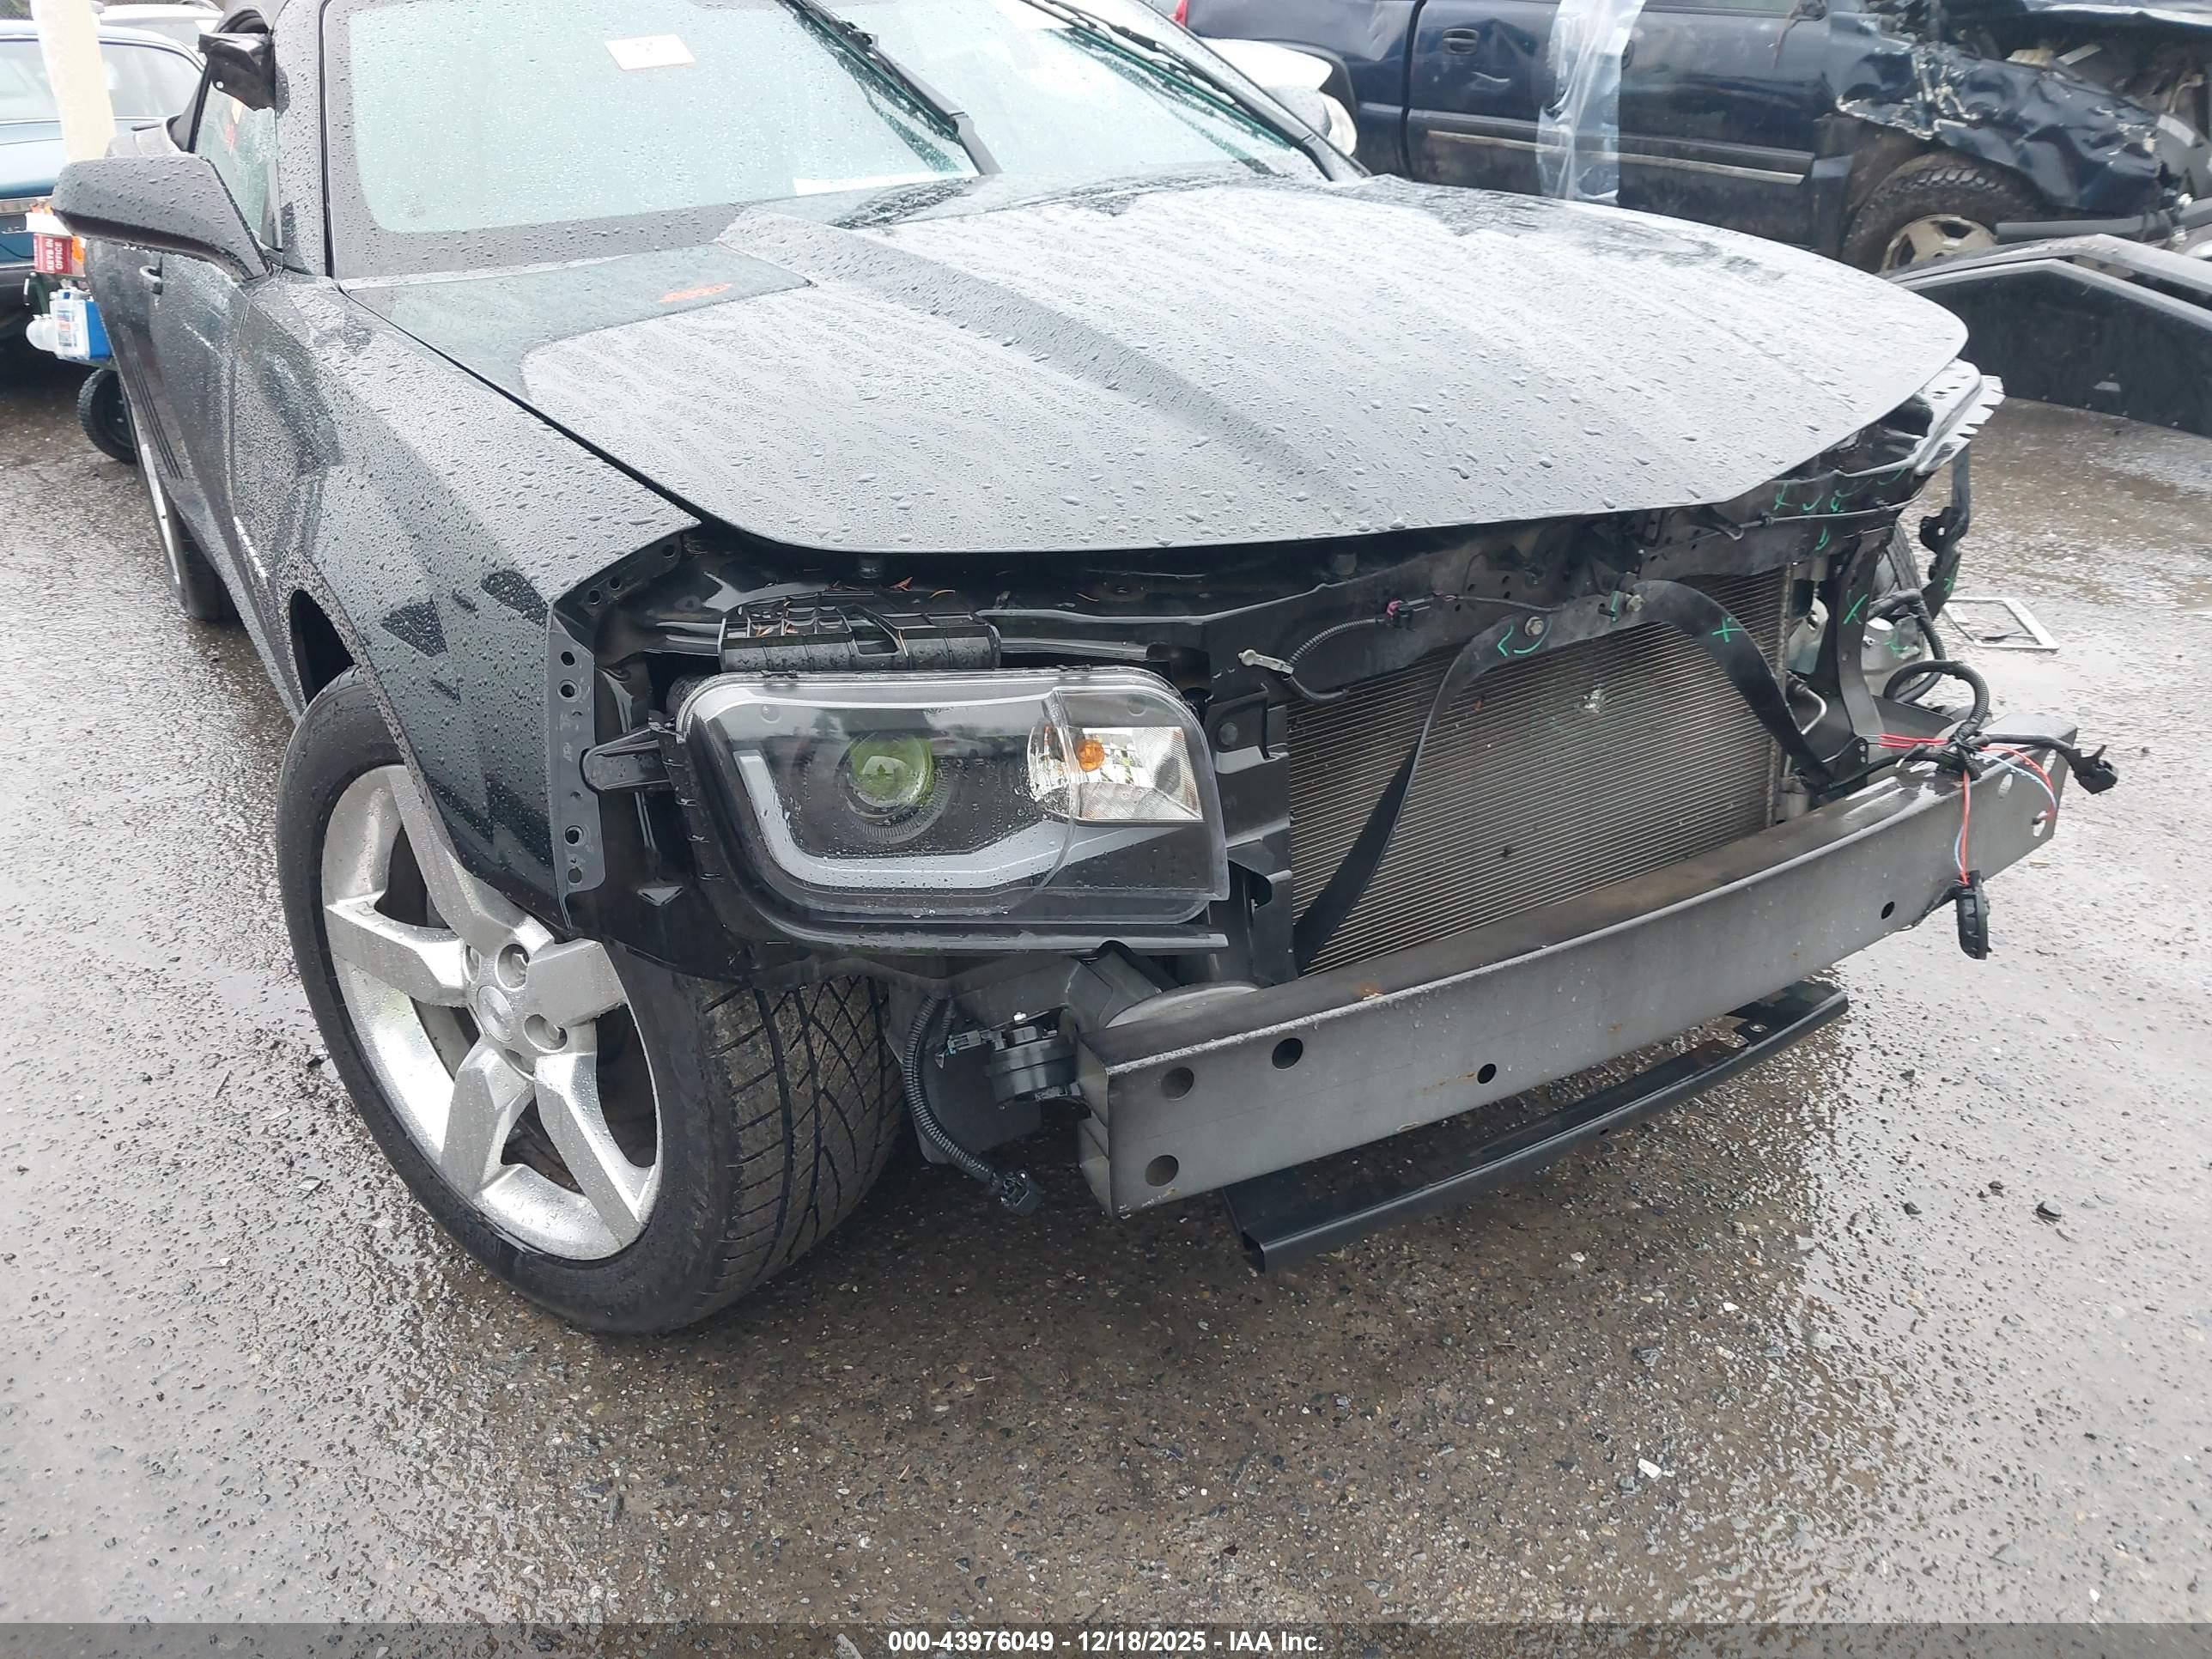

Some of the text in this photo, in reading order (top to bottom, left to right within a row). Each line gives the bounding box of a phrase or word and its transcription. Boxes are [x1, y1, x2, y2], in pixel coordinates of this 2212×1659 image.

[45, 239, 55, 271] KEYS IN
[54, 241, 64, 270] OFFICE
